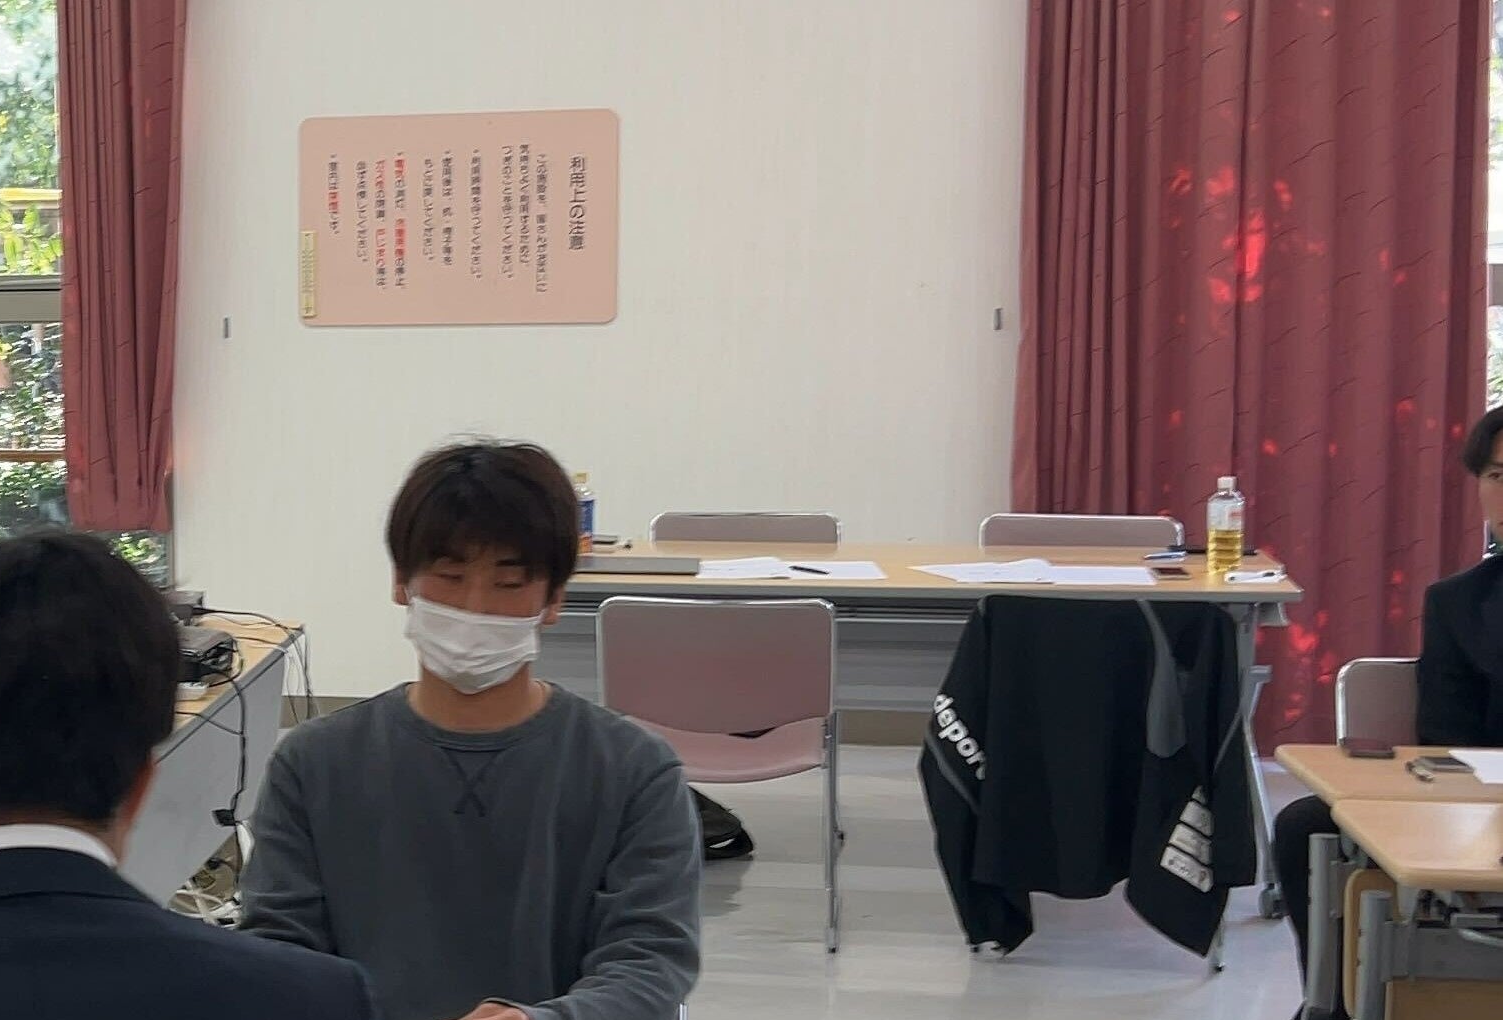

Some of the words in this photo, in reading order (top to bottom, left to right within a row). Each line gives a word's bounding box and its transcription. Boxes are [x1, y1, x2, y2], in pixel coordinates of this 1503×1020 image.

[569, 155, 586, 251] 利用上の注意
